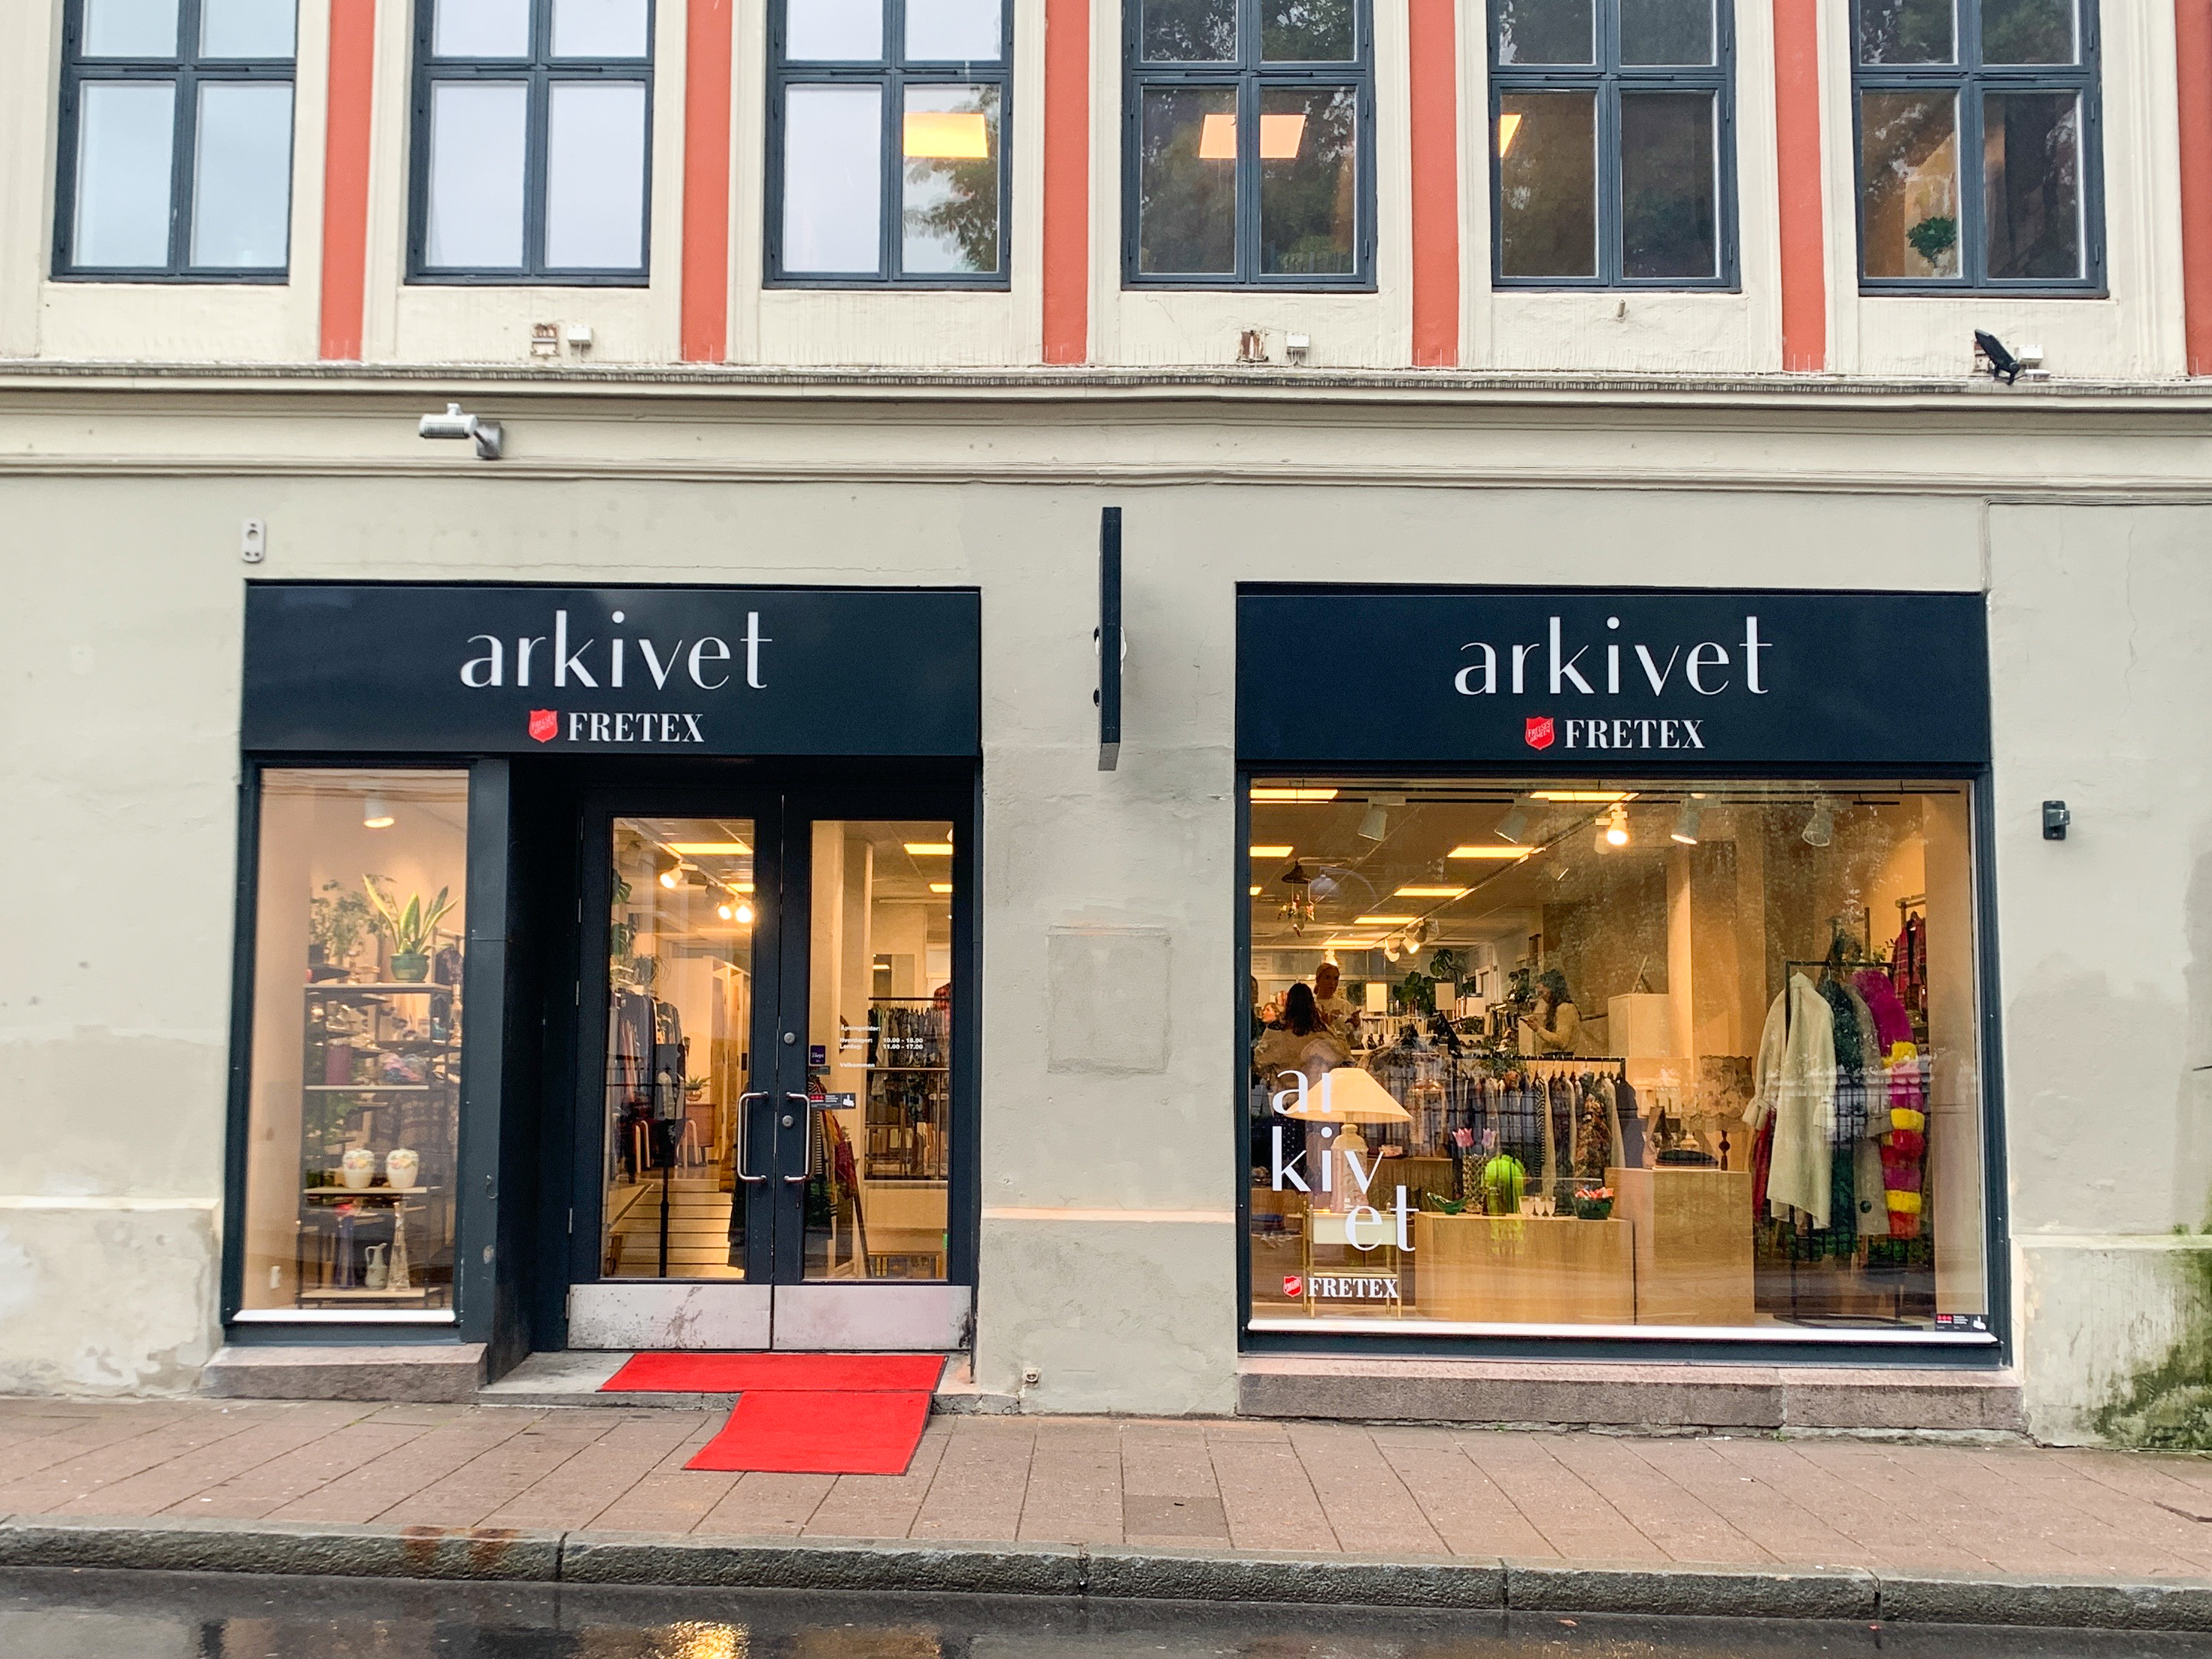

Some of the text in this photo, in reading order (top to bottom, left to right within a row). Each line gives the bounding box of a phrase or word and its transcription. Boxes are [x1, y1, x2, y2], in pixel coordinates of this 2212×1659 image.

[460, 609, 773, 690] arkivet
[1454, 615, 1774, 697] arkivet
[567, 712, 705, 743] FRETEX
[1564, 719, 1706, 750] FRETEX
[1272, 1126, 1384, 1195] kiv
[1345, 1185, 1420, 1252] et
[1308, 1277, 1399, 1299] FRETEX
